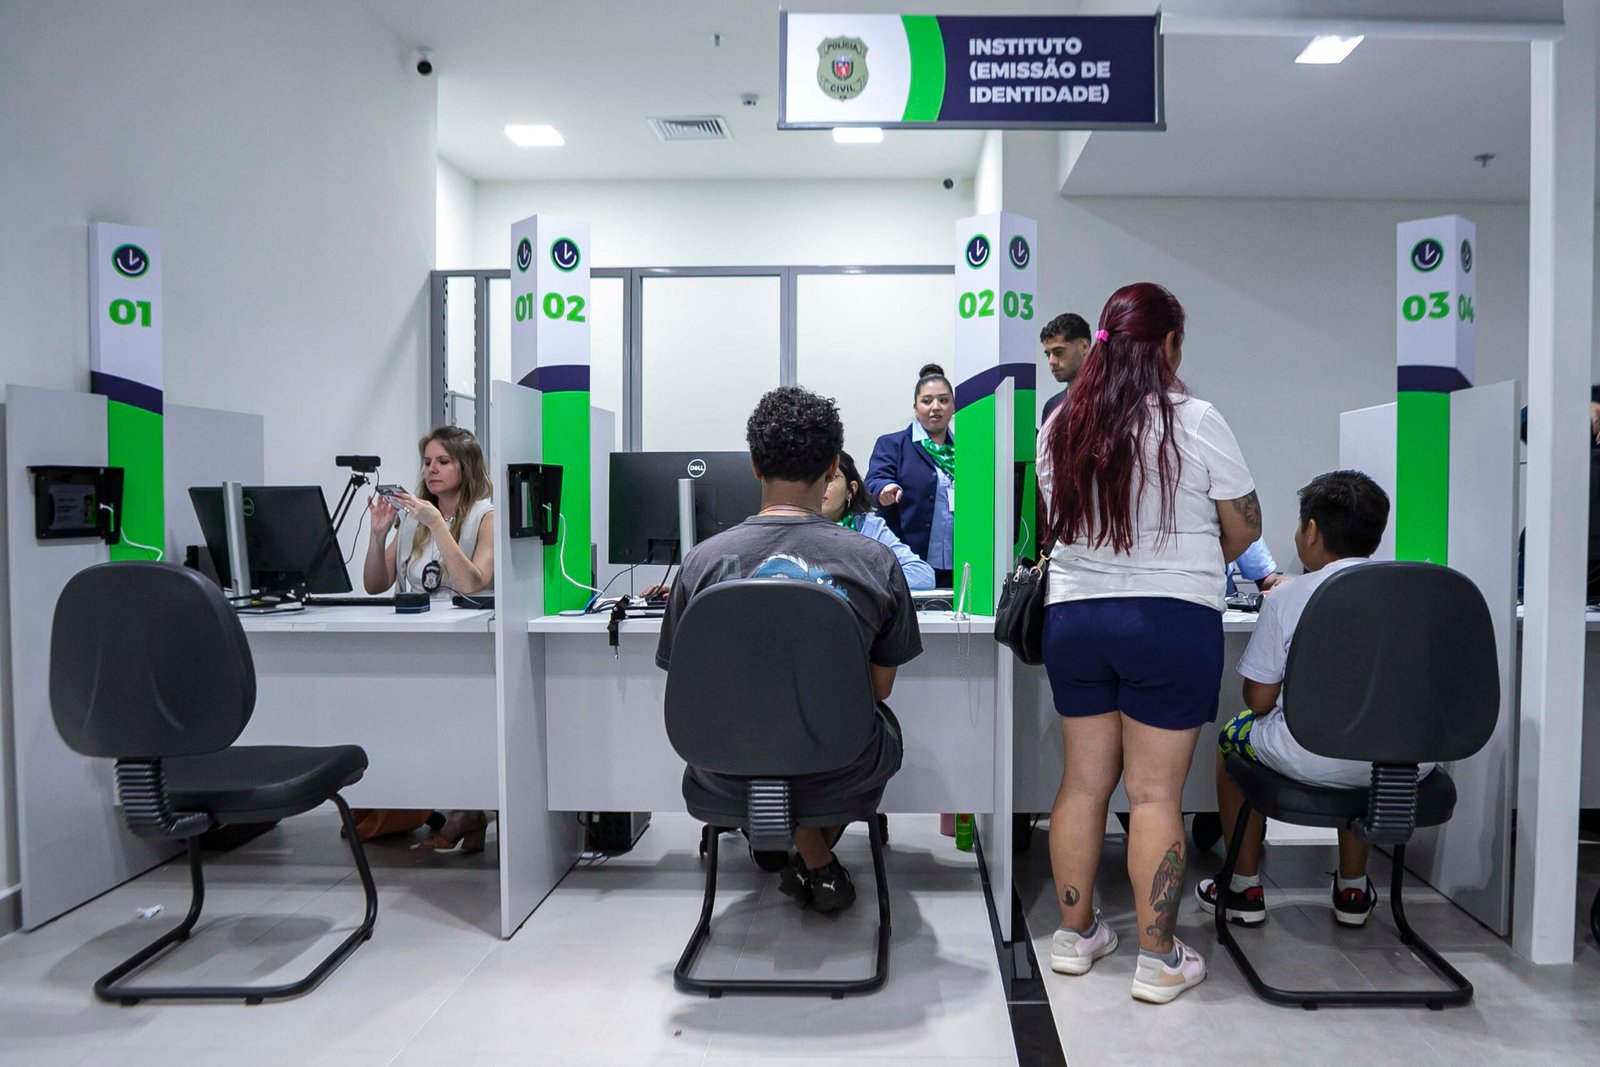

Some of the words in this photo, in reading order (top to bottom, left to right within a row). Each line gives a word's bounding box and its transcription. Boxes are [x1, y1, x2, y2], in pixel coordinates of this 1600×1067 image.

[828, 41, 857, 50] POLÍCIA
[969, 37, 1082, 55] INSTITUTO
[969, 58, 1076, 81] (EMISSÃO
[1081, 61, 1111, 78] DE
[830, 84, 855, 93] CIVIL
[969, 84, 1110, 104] IDENTIDADE)
[109, 298, 152, 328] 01
[515, 292, 533, 322] 01
[542, 292, 586, 323] 02
[958, 289, 995, 319] 02
[1003, 290, 1034, 321] 03
[1402, 291, 1450, 322] 03
[1458, 293, 1475, 324] 04
